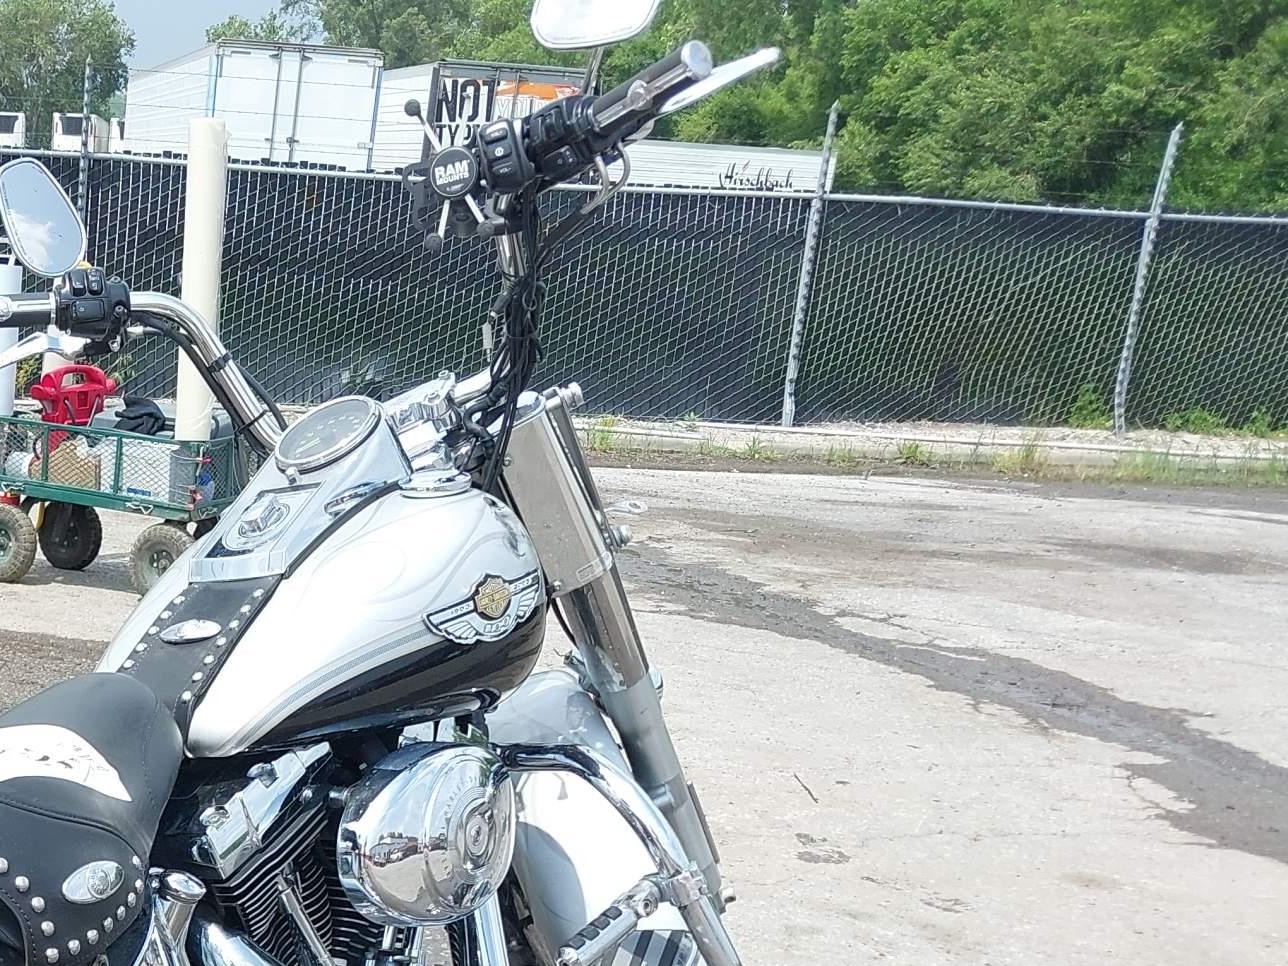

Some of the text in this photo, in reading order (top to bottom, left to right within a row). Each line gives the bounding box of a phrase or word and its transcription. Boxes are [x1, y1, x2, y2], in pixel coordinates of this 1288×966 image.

[435, 79, 500, 122] NOT
[434, 159, 469, 179] RAM
[436, 172, 470, 186] MOUNTS
